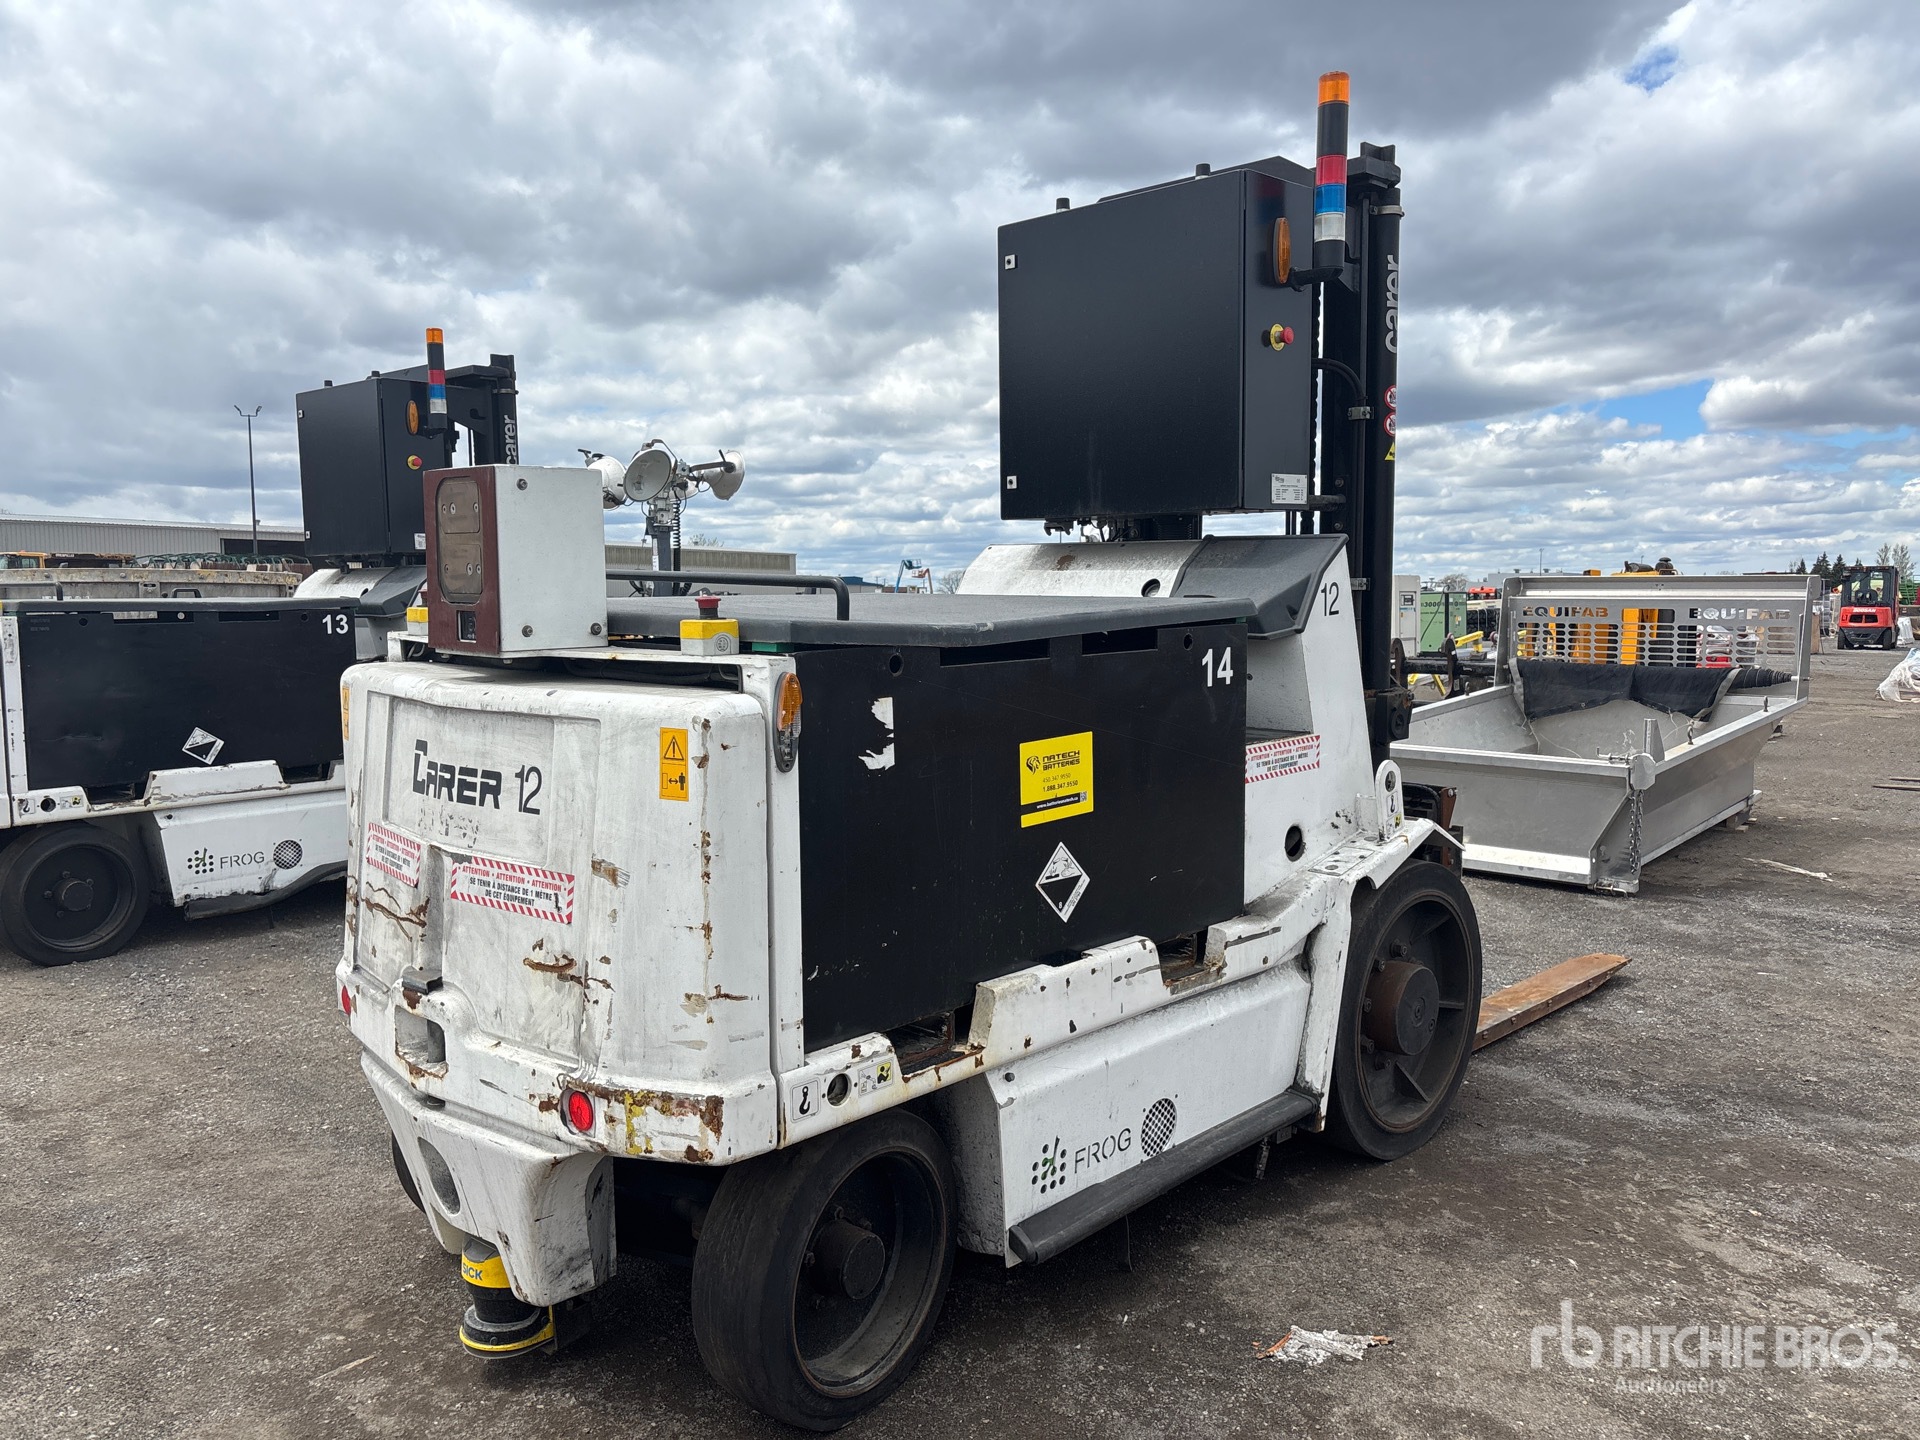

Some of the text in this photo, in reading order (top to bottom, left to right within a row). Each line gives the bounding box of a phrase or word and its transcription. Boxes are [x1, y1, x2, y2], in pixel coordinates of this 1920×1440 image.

[1385, 254, 1400, 354] carer
[1321, 582, 1340, 616] 12
[1522, 606, 1608, 618] EQUIFAB
[1689, 608, 1791, 620] EQUIFAB
[322, 614, 349, 634] 13
[1202, 646, 1234, 688] 14
[1042, 750, 1080, 762] NATECH
[1043, 759, 1080, 771] BATTERIES
[412, 739, 542, 815] CARER 12
[220, 852, 264, 869] FROG
[462, 866, 562, 892] ATTENTION ATTENTION ATTENTION
[470, 877, 476, 885] SE
[477, 878, 491, 888] TENIR
[497, 882, 521, 894] DISTANCE
[522, 888, 529, 896] DE
[485, 889, 492, 898] DE
[493, 891, 502, 900] CET
[1074, 1128, 1131, 1174] FROG
[462, 1263, 483, 1281] SICK
